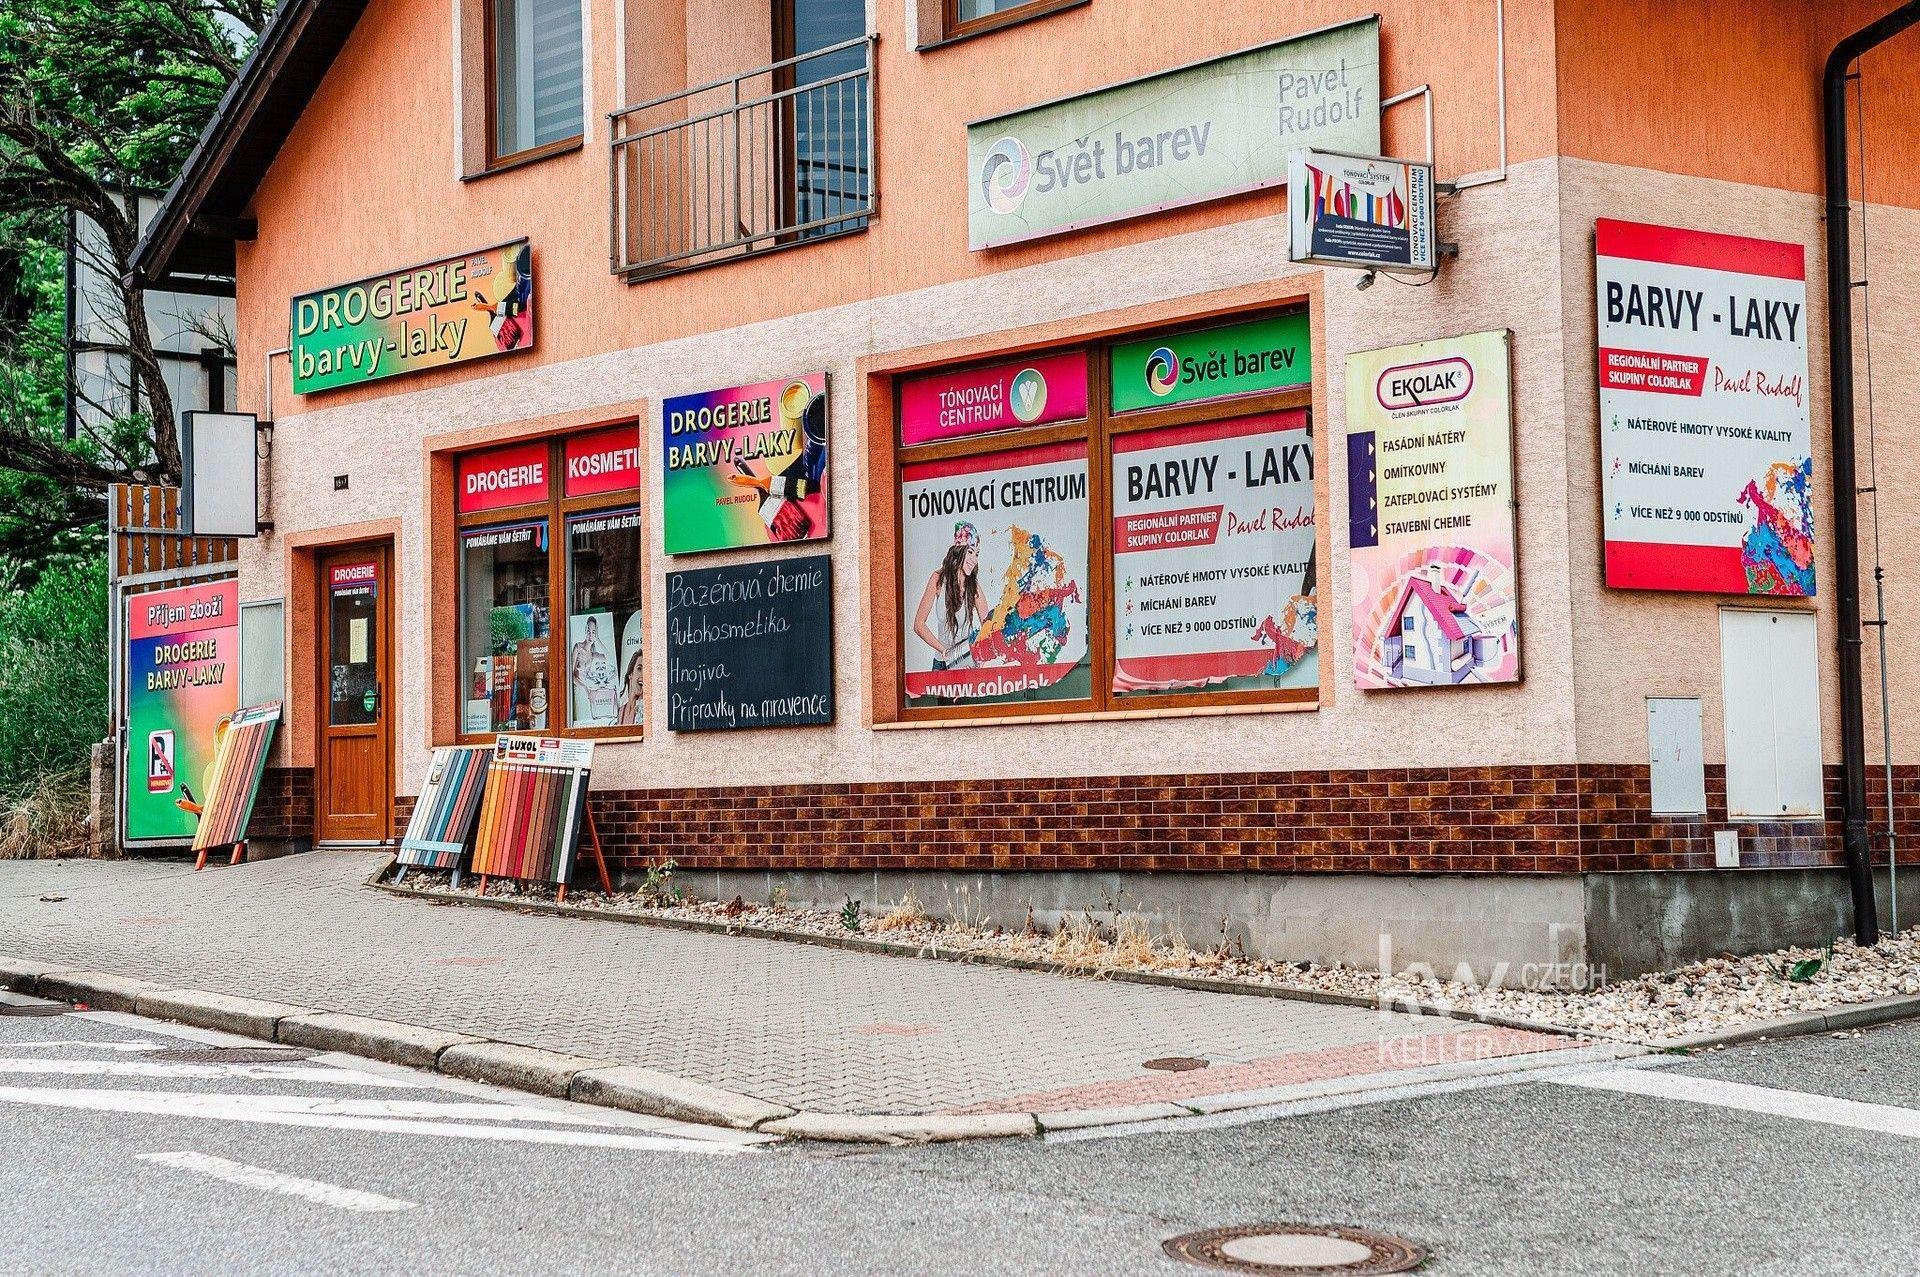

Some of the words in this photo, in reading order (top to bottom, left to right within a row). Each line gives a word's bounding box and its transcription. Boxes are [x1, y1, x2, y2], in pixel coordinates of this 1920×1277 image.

[1278, 58, 1348, 103] Pavel
[1278, 88, 1363, 136] Rudolf
[1035, 137, 1105, 194] Svět
[1115, 121, 1212, 176] barev
[298, 260, 468, 339] DROGERIE
[1607, 281, 1703, 332] BARVY
[1730, 295, 1800, 342] LAKY
[298, 314, 468, 380] barvy-laky
[1182, 350, 1228, 384] Svět
[1233, 347, 1296, 377] barev
[1608, 353, 1661, 372] REGIONÁLNÍ
[1661, 359, 1699, 374] PARTNER
[938, 379, 1003, 409] TÓNOVACÍ
[1608, 371, 1645, 387] SKUPINY
[1647, 375, 1691, 390] COLORLAK
[1714, 366, 1751, 393] Pavel
[1756, 372, 1802, 408] Rudolf
[670, 397, 772, 436] DROGERIE
[939, 402, 1003, 427] CENTRUM
[1430, 404, 1460, 414] COLORLAK
[1382, 435, 1425, 453] FASÁDNÍ
[1427, 431, 1466, 448] NÁTĚRY
[1627, 416, 1678, 434] NÁTĚROVÉ
[1680, 422, 1713, 436] HMOTY
[1716, 423, 1753, 440] VYSOKÉ
[1755, 428, 1793, 443] KVALITY
[568, 447, 640, 479] KOSMETI
[669, 428, 796, 470] BARVY-LAKY
[467, 463, 543, 494] DROGERIE
[1127, 454, 1219, 502] BARVY
[1245, 443, 1314, 488] LAKY
[1383, 462, 1446, 481] OMÍTKOVINY
[1628, 460, 1672, 477] MÍCHÁNÍ
[1673, 465, 1705, 478] BAREV
[716, 496, 733, 506] PAVEL
[734, 494, 758, 504] RUDOLF
[909, 478, 996, 519] TÓNOVACÍ
[1000, 473, 1086, 508] CENTRUM
[1384, 488, 1449, 507] ZATEPLOVACÍ
[1450, 483, 1497, 502] SYSTÉMY
[572, 517, 605, 535] POMÁHÁME
[606, 516, 620, 531] VÁM
[1127, 514, 1178, 532] REGIONÁLNÍ
[1179, 510, 1217, 525] PARTNER
[1227, 509, 1266, 537] Pavel
[1272, 505, 1315, 531] Rudol
[1385, 516, 1431, 535] STAVEBNÍ
[1433, 515, 1471, 530] CHEMIE
[1630, 503, 1653, 519] VÍCE
[1655, 504, 1674, 520] NEŽ
[1676, 508, 1682, 520] 9
[1684, 509, 1701, 522] 000
[1703, 508, 1744, 525] ODSTÍNŮ
[1127, 533, 1163, 547] SKUPINY
[1165, 528, 1210, 543] COLORLAK
[334, 565, 375, 581] DROGERIE
[1140, 571, 1190, 587] NÁTĚROVÉ
[1192, 569, 1227, 583] HMOTY
[1229, 563, 1271, 580] VYSOKÉ
[1272, 561, 1309, 576] KVALIT
[668, 568, 763, 613] Bazénová
[768, 565, 823, 597] chemie
[1140, 597, 1182, 612] MÍCHÁNÍ
[1184, 595, 1217, 608] BAREV
[148, 606, 186, 628] Příjem
[190, 595, 223, 619] zboží
[1141, 622, 1163, 636] VÍCE
[1164, 620, 1183, 635] NEŽ
[1185, 621, 1192, 633] 9
[1193, 620, 1211, 633] 000
[1213, 615, 1257, 631] ODSTÍNŮ
[670, 607, 791, 646] Autokosmetika
[155, 638, 217, 666] DROGERIE
[147, 662, 225, 691] BARVY-LAKY
[670, 657, 731, 690] Hnojiva
[671, 690, 736, 729] Přípravky
[741, 703, 758, 718] na
[762, 694, 828, 718] mravence
[509, 740, 537, 752] LUXOL
